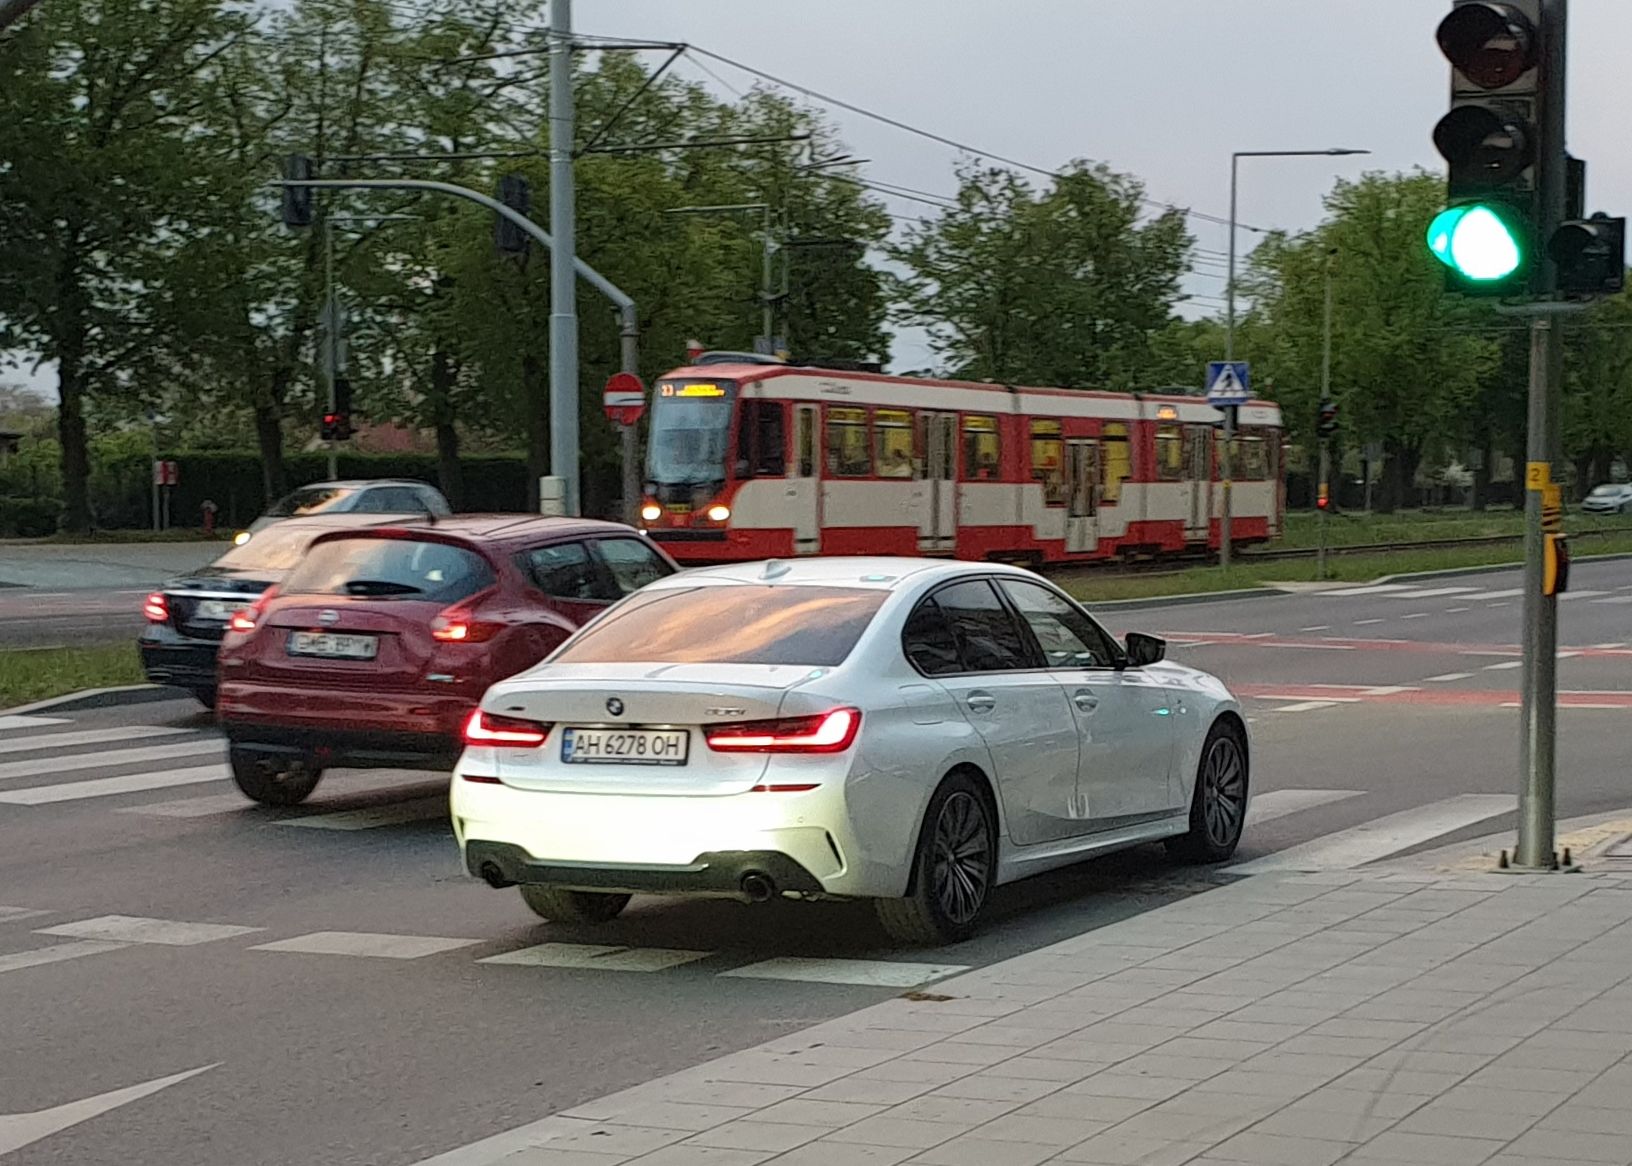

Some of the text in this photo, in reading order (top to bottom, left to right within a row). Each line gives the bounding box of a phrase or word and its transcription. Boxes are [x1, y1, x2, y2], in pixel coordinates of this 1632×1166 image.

[1530, 468, 1540, 482] 2
[574, 734, 680, 756] AH 6278 OH
